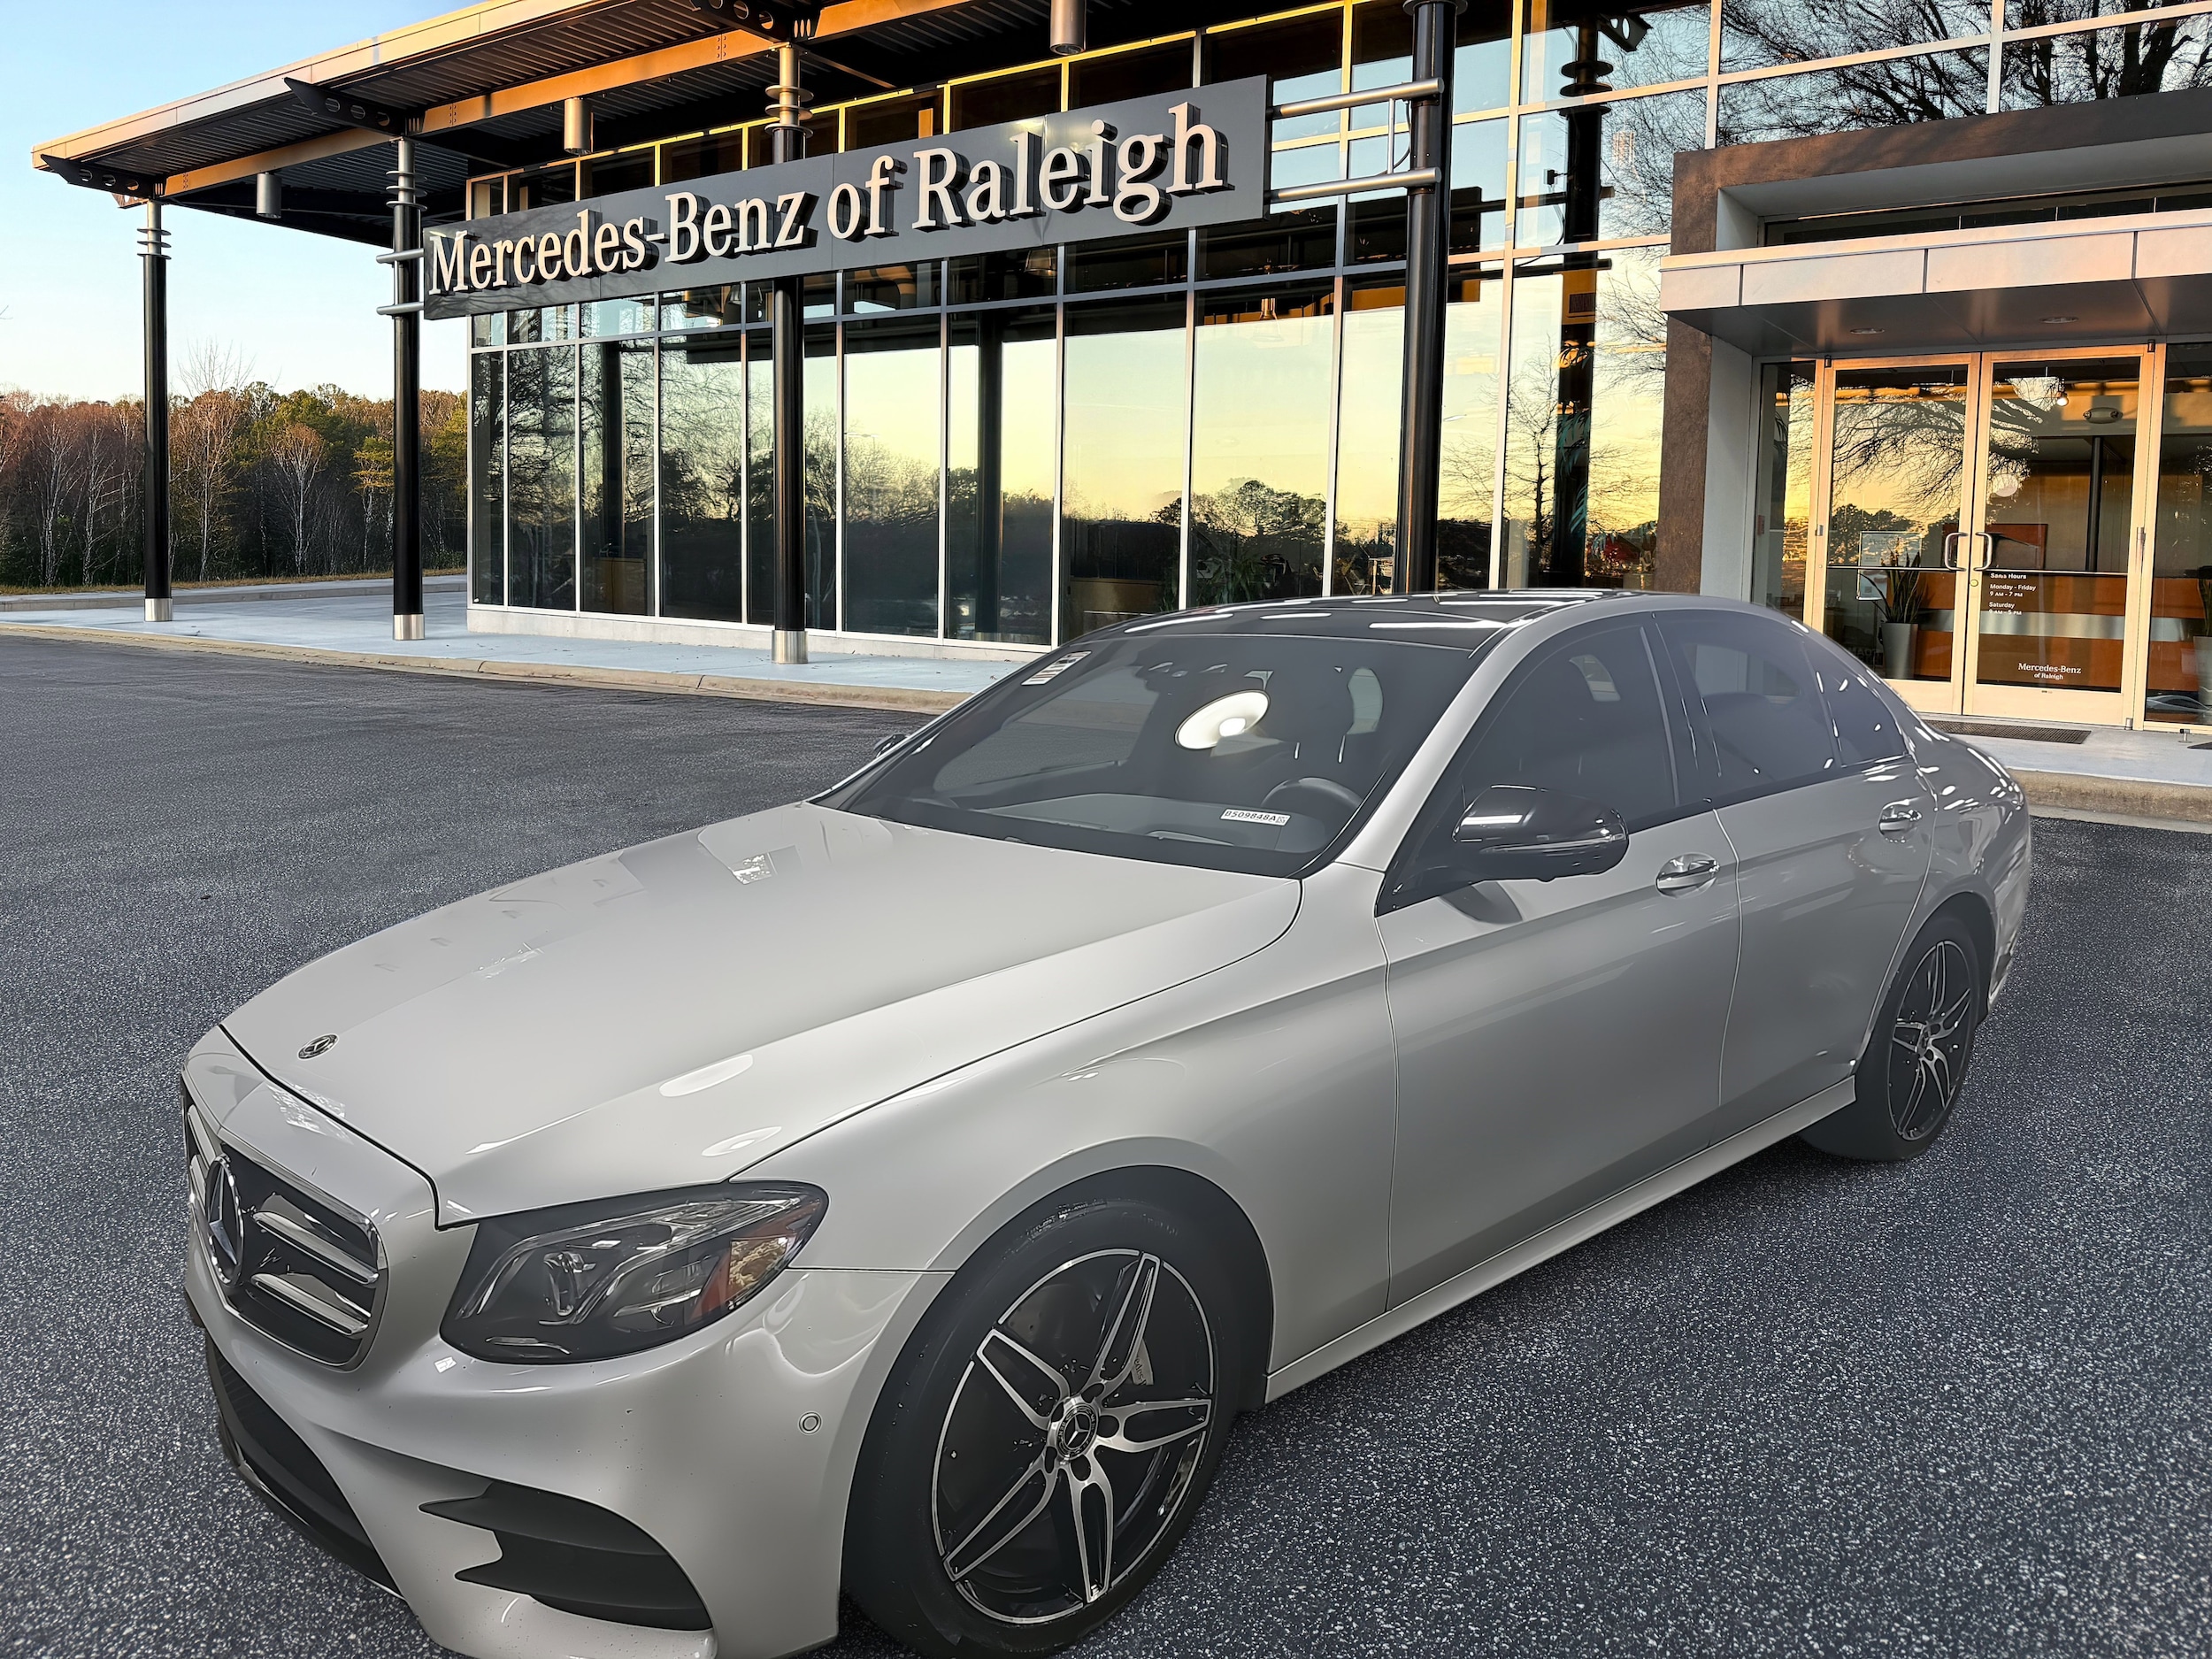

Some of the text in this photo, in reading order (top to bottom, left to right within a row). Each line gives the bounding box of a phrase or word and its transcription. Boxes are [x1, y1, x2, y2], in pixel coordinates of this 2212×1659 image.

[428, 101, 1229, 296] Mercedes-Benz of Raleigh
[2018, 663, 2081, 673] Mercedes-Benz
